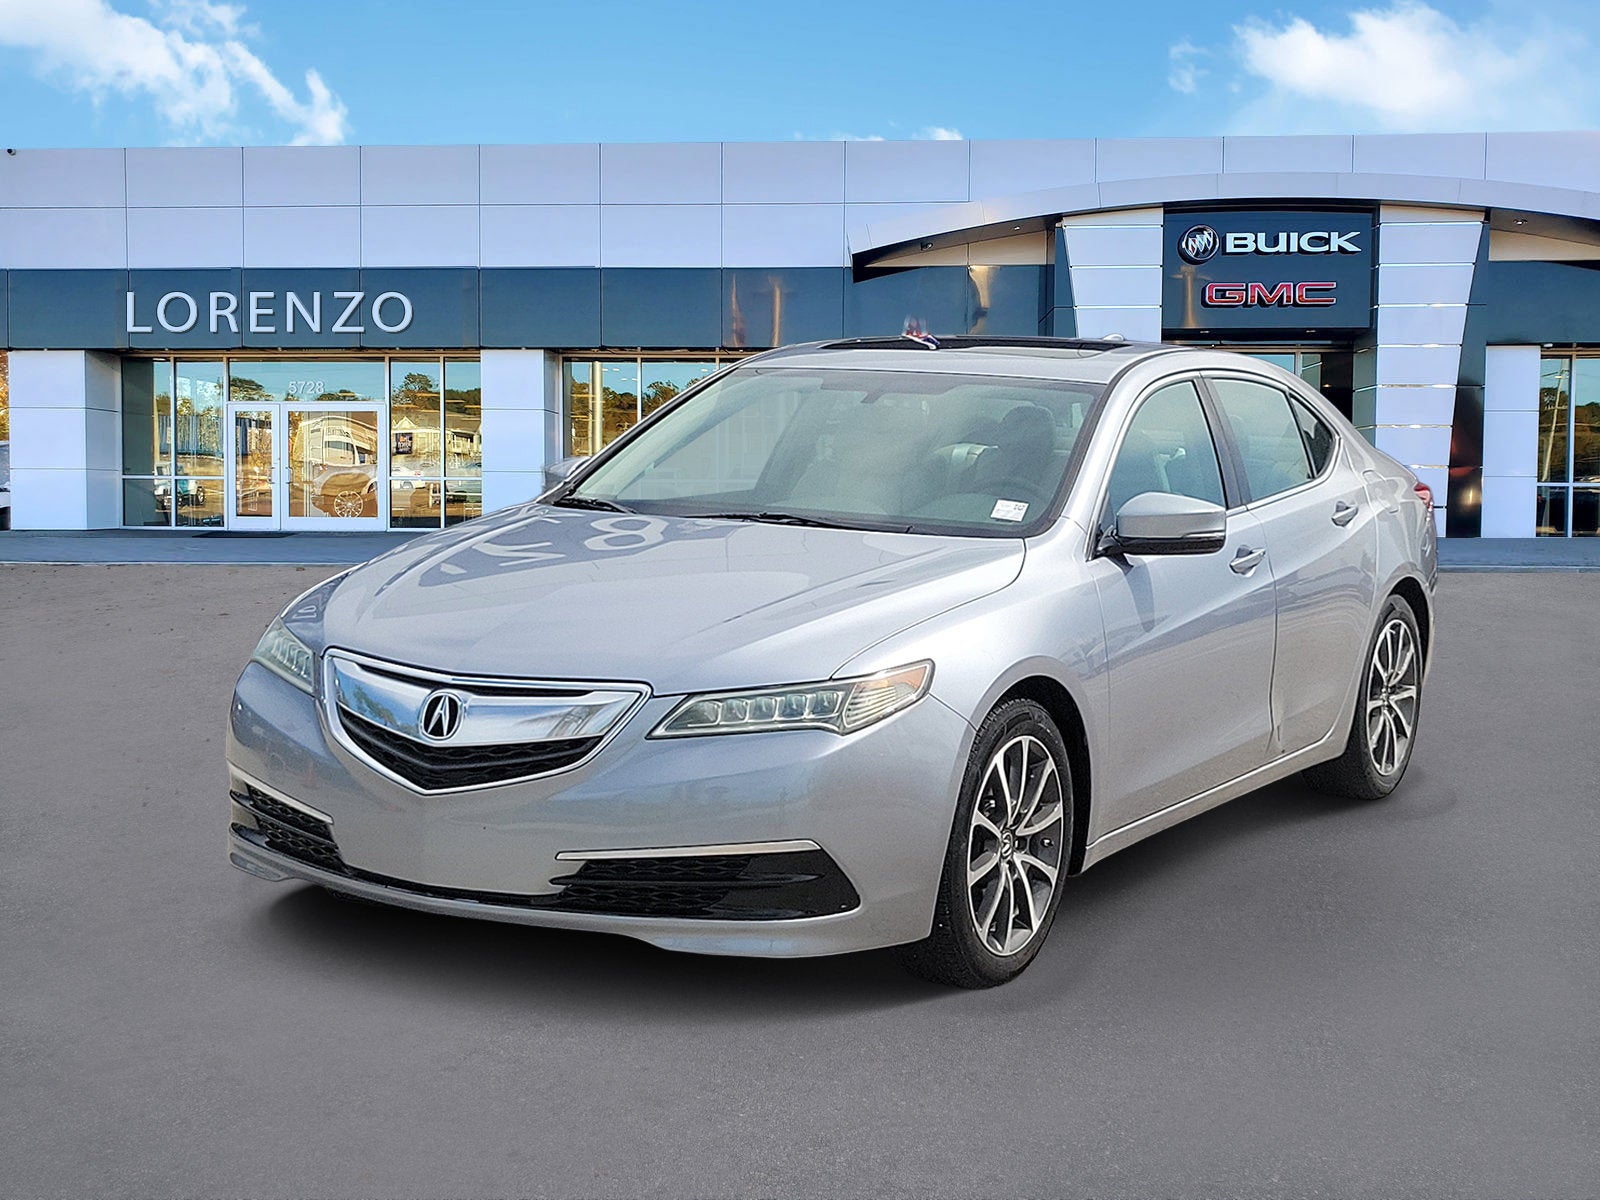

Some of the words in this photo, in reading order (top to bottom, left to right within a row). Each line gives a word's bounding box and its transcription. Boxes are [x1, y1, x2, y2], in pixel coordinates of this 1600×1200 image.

[1225, 231, 1362, 253] BUICK
[1205, 282, 1337, 305] GMC
[126, 291, 413, 333] LORENZO
[288, 380, 325, 394] 5728
